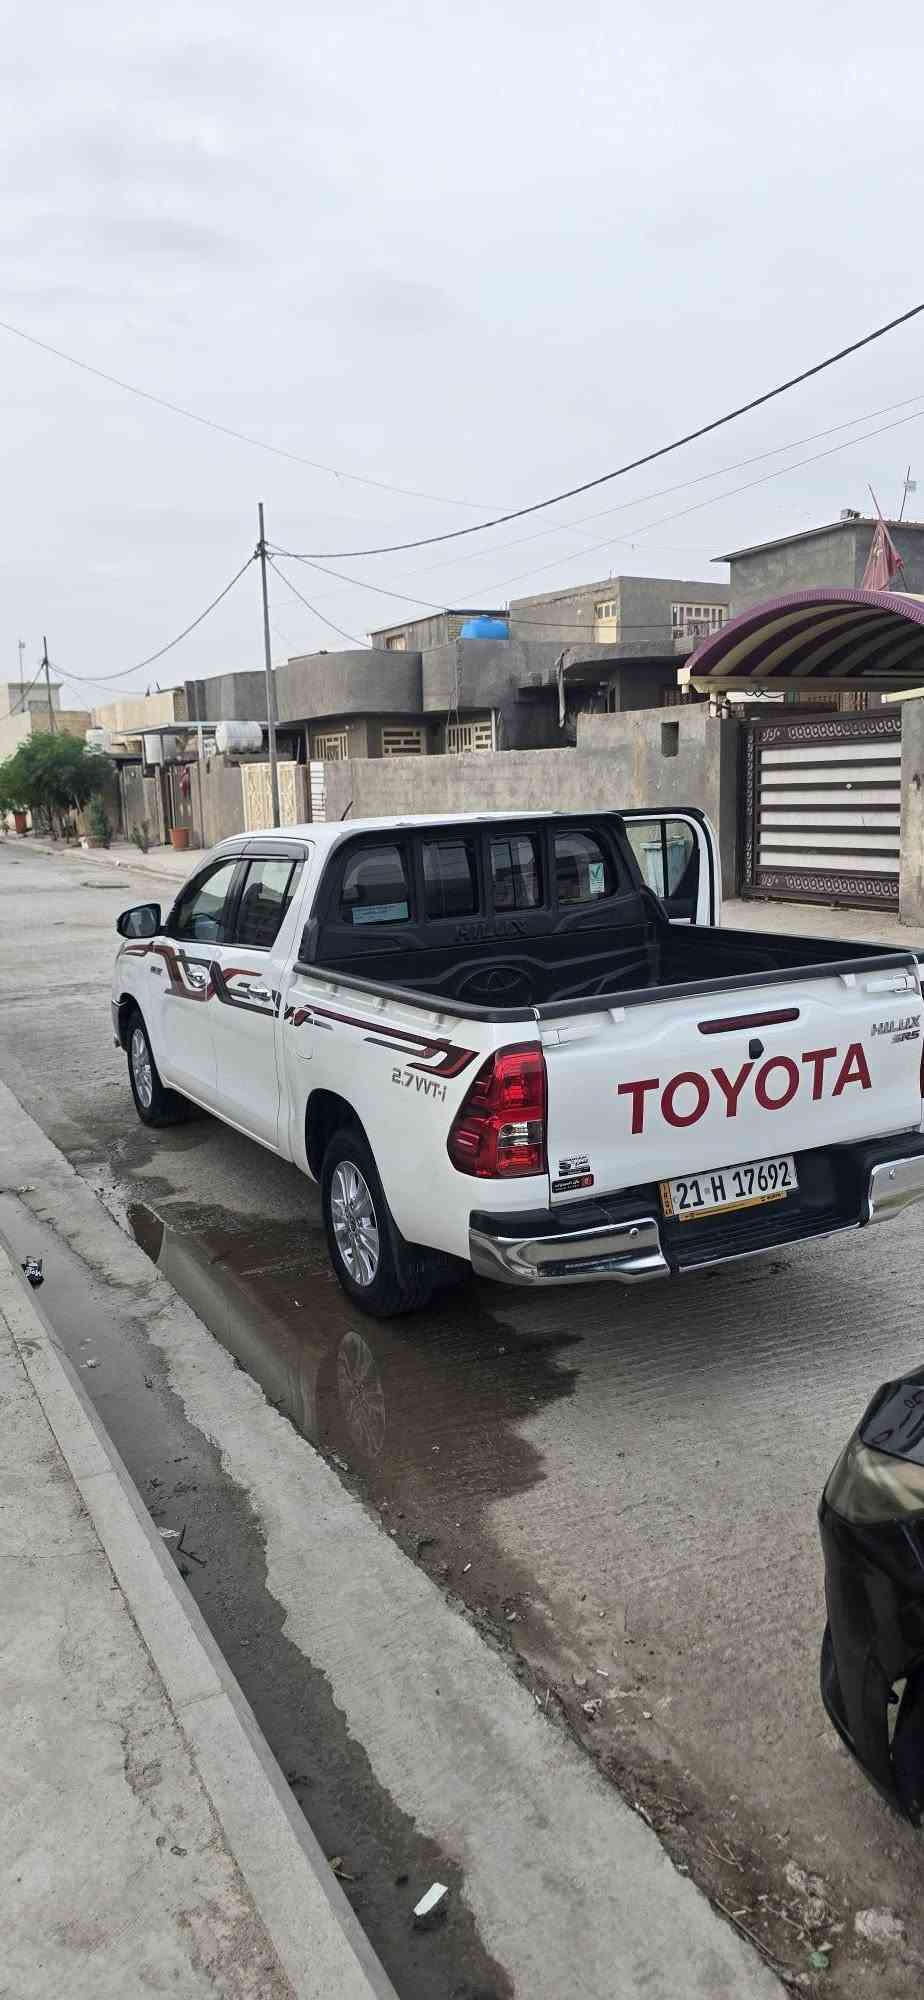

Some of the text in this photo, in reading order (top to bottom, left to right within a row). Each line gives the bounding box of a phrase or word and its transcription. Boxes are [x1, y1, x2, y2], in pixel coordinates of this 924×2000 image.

[617, 1043, 872, 1135] TOYOTA
[676, 1180, 705, 1209] 21
[710, 1175, 726, 1202] H
[732, 1162, 792, 1198] 17692
